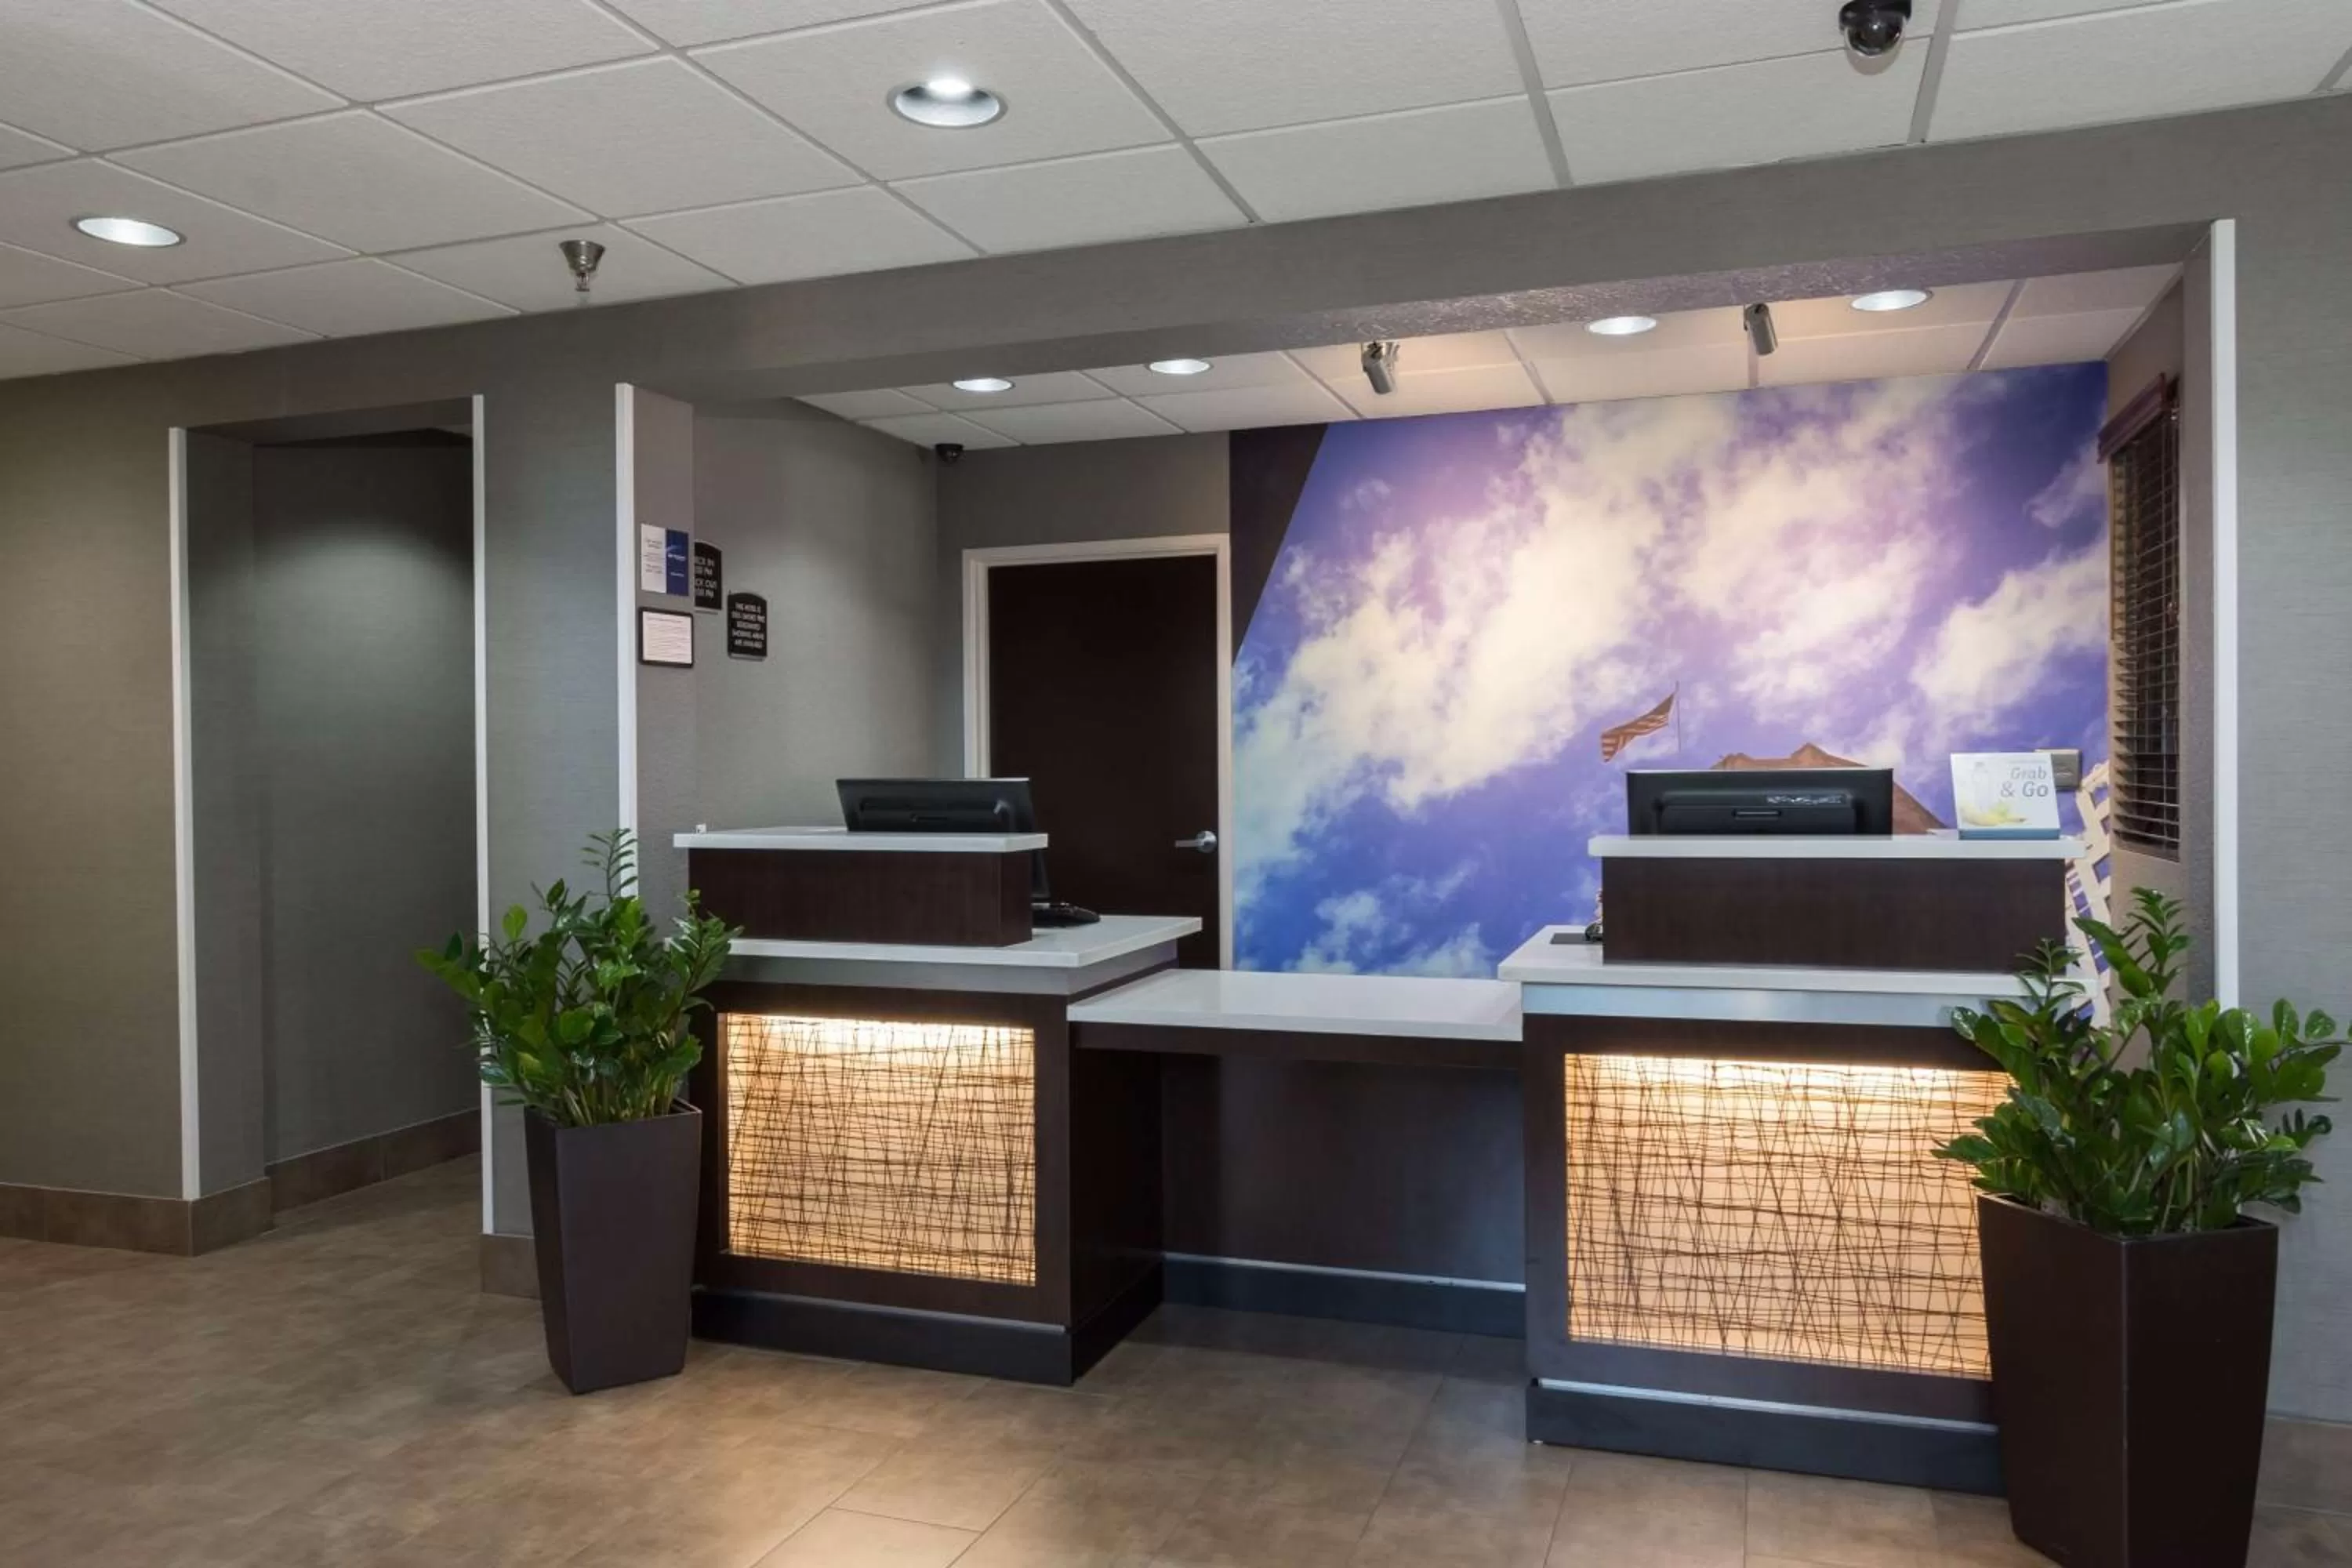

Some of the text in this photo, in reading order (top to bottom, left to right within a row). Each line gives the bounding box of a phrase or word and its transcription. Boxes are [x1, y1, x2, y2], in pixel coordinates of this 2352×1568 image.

[2010, 766, 2047, 779] Grab
[2000, 781, 2049, 797] & Go
